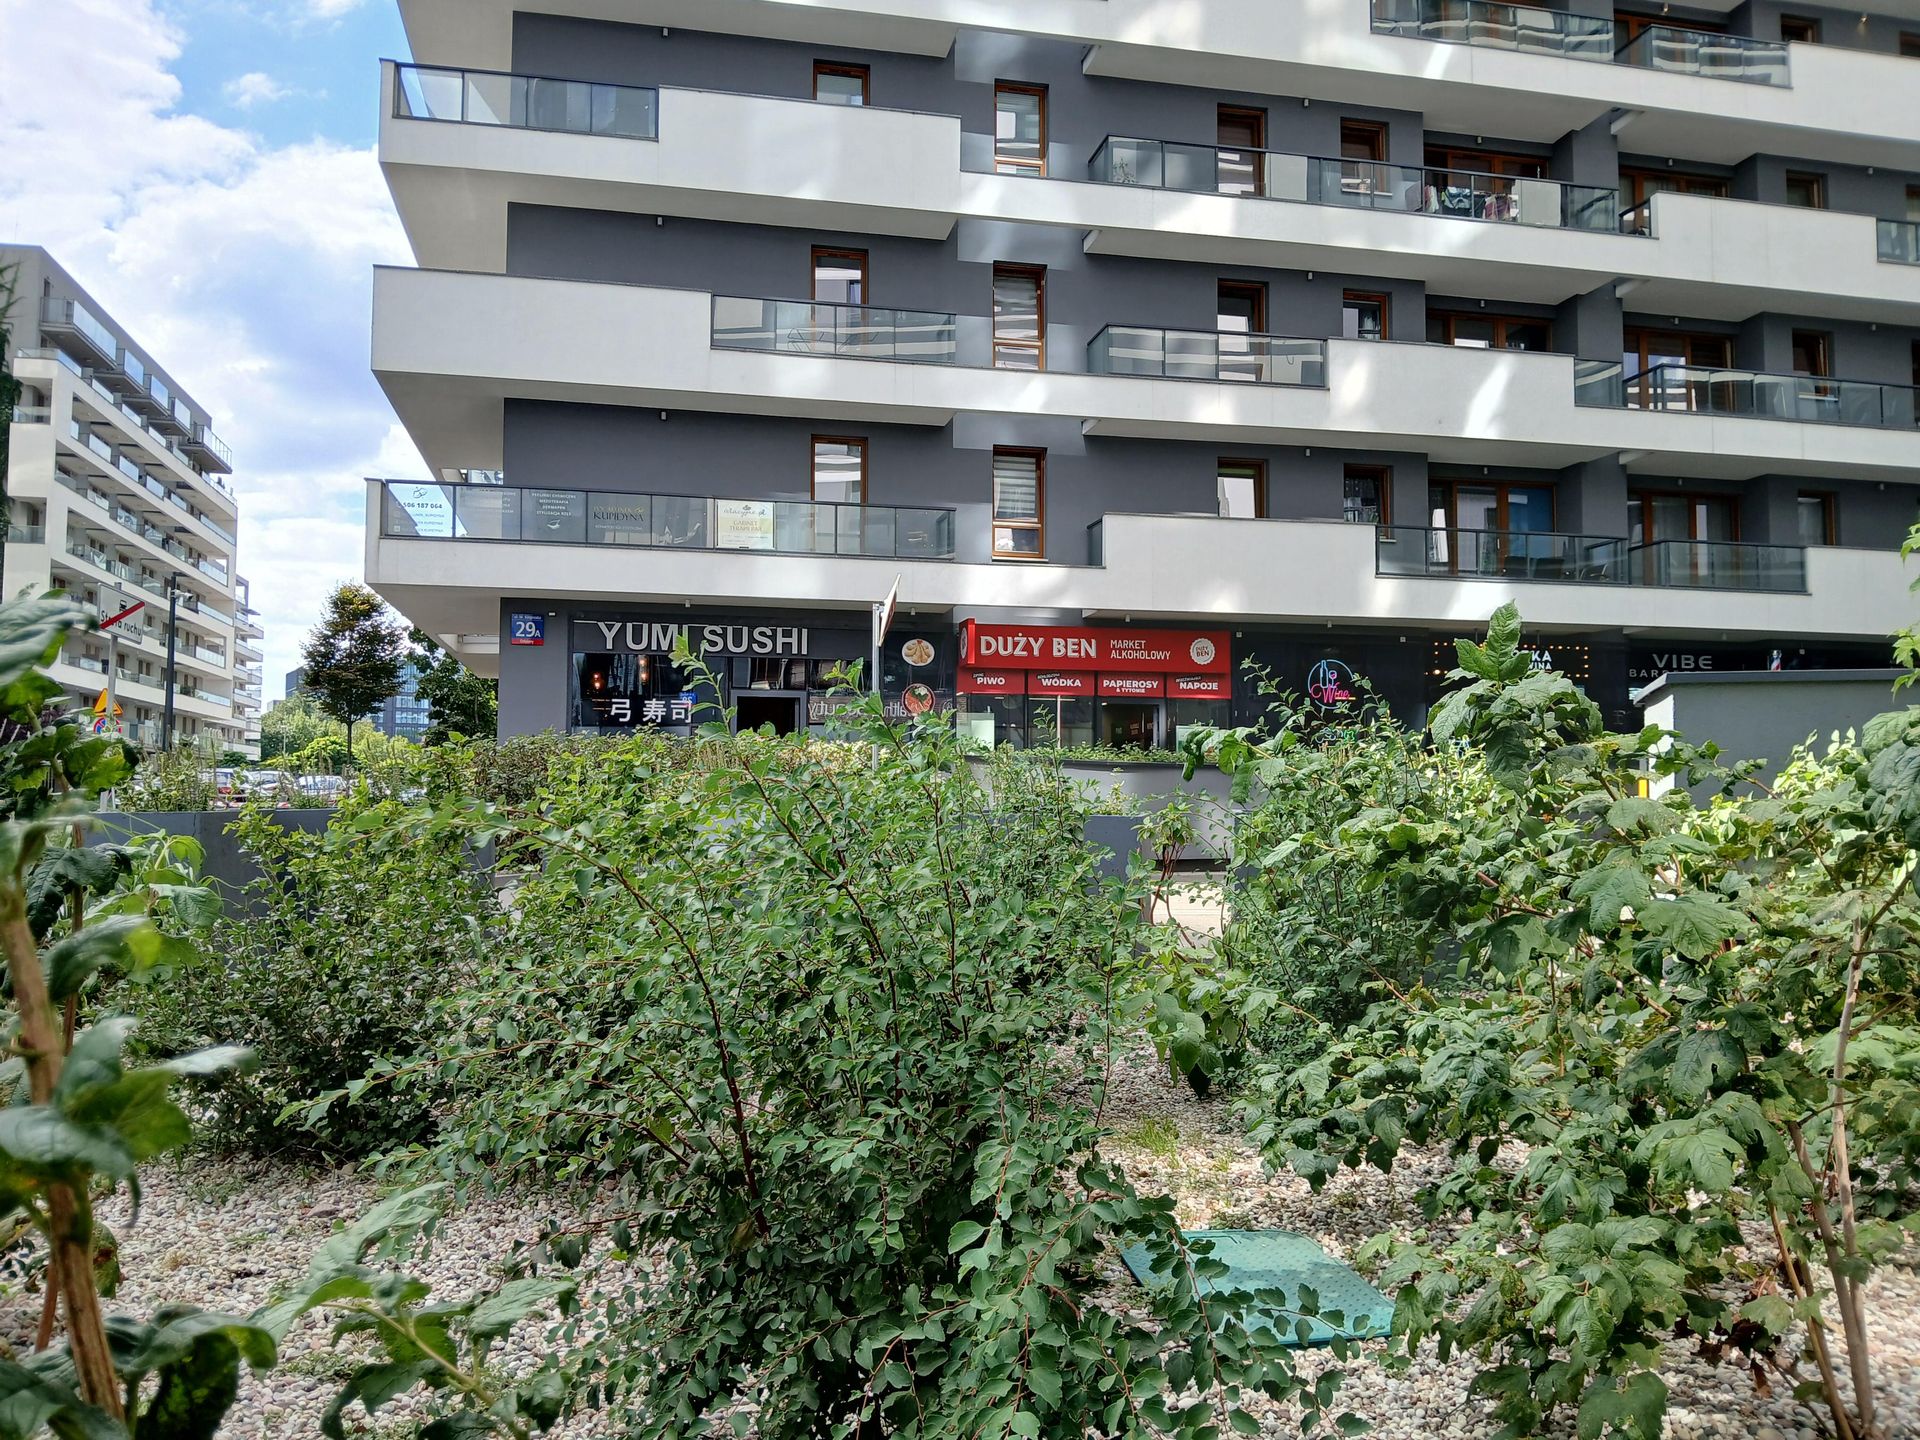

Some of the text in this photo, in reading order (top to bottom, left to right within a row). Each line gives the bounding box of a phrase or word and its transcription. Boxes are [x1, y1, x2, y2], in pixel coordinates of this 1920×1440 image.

[593, 511, 644, 522] KUPIDYNA
[124, 622, 142, 636] ruchu
[596, 622, 809, 655] YUMI SUSHI
[980, 633, 1045, 657] DUŻY
[1052, 637, 1097, 658] BEN
[1110, 640, 1146, 649] MARKET
[1110, 650, 1171, 660] ALKOHOLOWY
[1652, 654, 1713, 669] VIBE
[977, 677, 1006, 685] PIWO
[1042, 678, 1081, 687] WÓDKA
[1103, 680, 1158, 689] PAPIEROSY
[1180, 682, 1219, 690] NAPOJE
